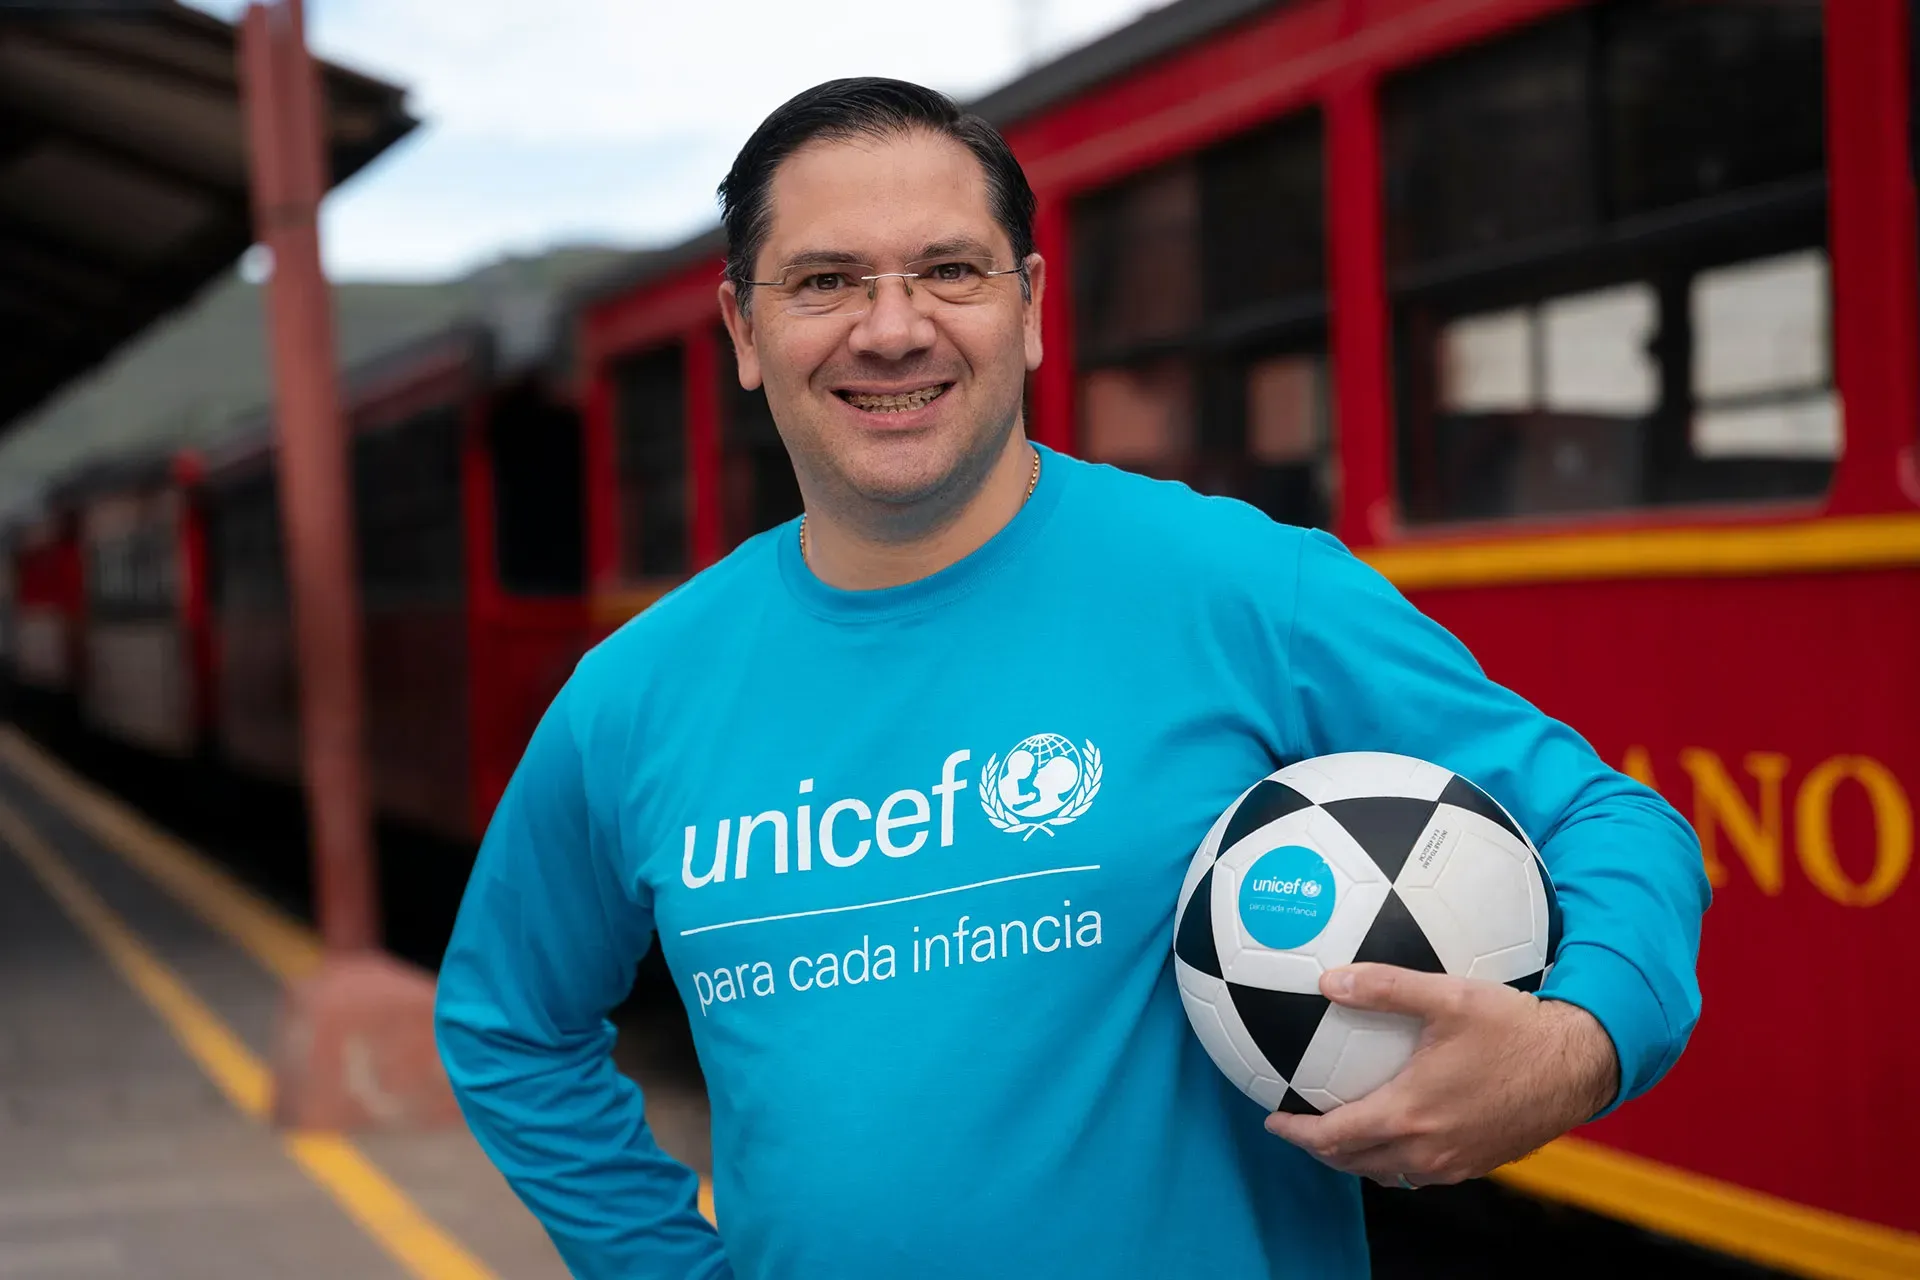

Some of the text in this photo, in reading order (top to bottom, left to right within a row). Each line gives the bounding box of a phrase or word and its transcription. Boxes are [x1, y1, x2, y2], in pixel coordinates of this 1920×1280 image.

[681, 749, 971, 889] unicef
[1249, 903, 1317, 917] para cada infancia
[1253, 876, 1302, 895] unicef
[693, 900, 1102, 1017] para cada infancia
